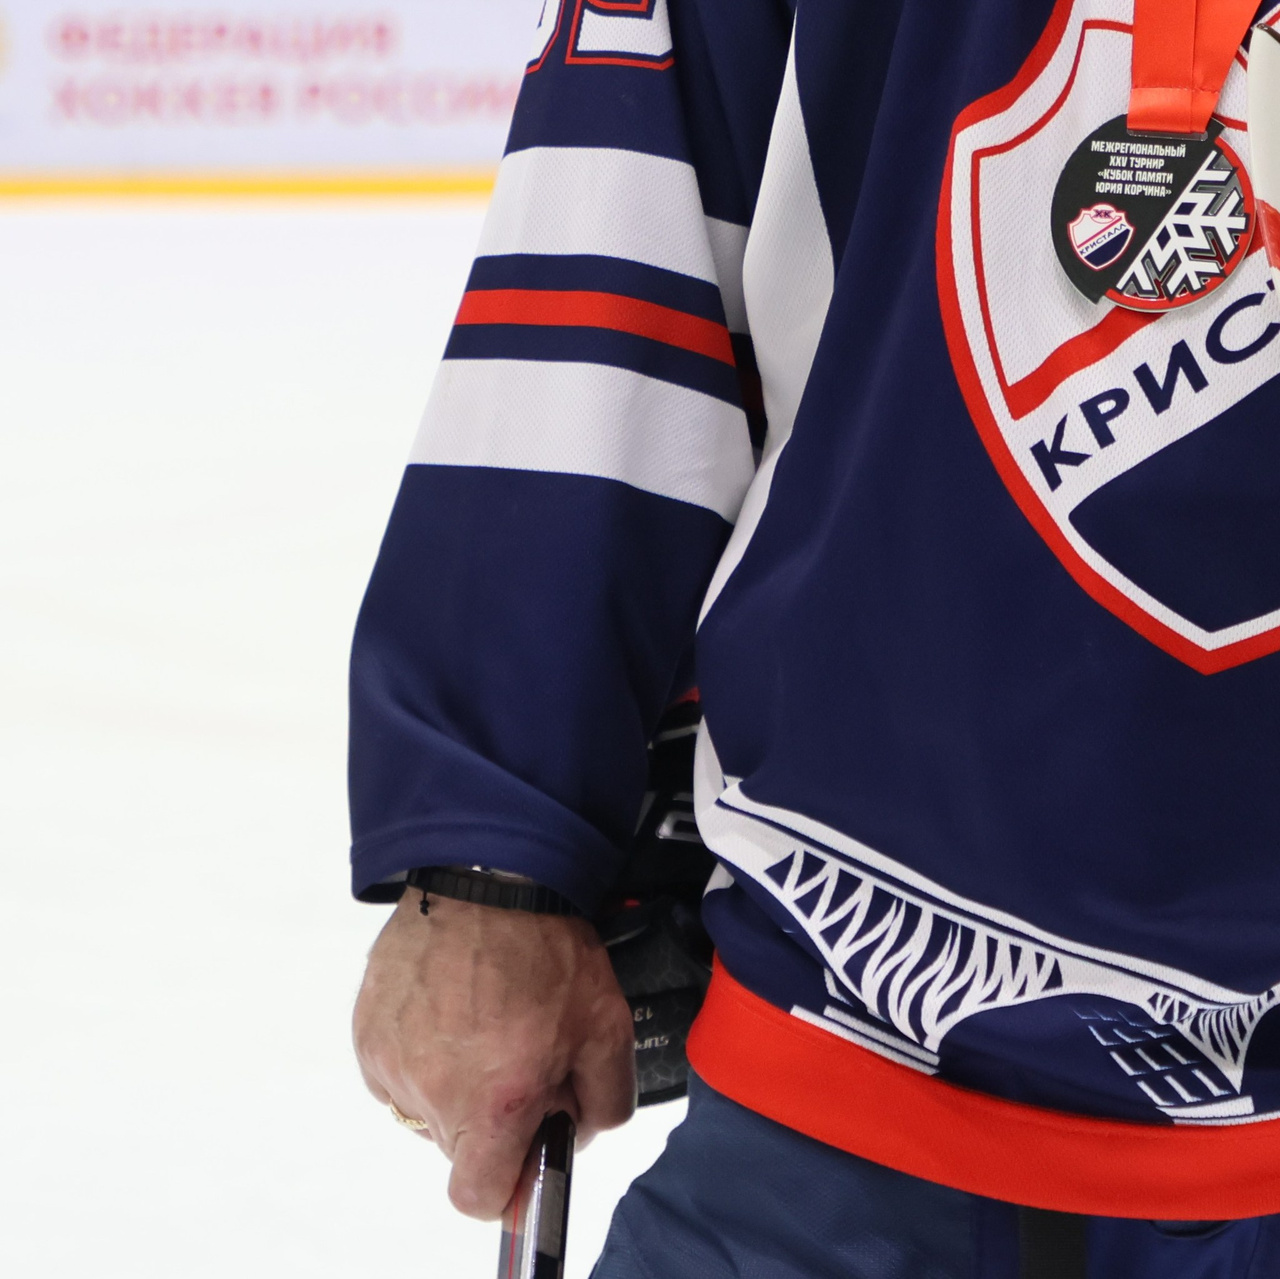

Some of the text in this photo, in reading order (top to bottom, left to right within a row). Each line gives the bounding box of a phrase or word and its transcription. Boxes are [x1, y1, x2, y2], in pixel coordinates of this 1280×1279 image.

[1091, 140, 1187, 158] МЕЖРЕГИОНАЛЬНЫЙ
[1109, 155, 1165, 170] XXV ТУРНИР
[1097, 169, 1174, 184] «КУБОК ПАМЯТИ
[1095, 181, 1172, 197] ЮРИЯ КОРЧИНА»
[1079, 223, 1127, 257] КРИСТАЛЛ
